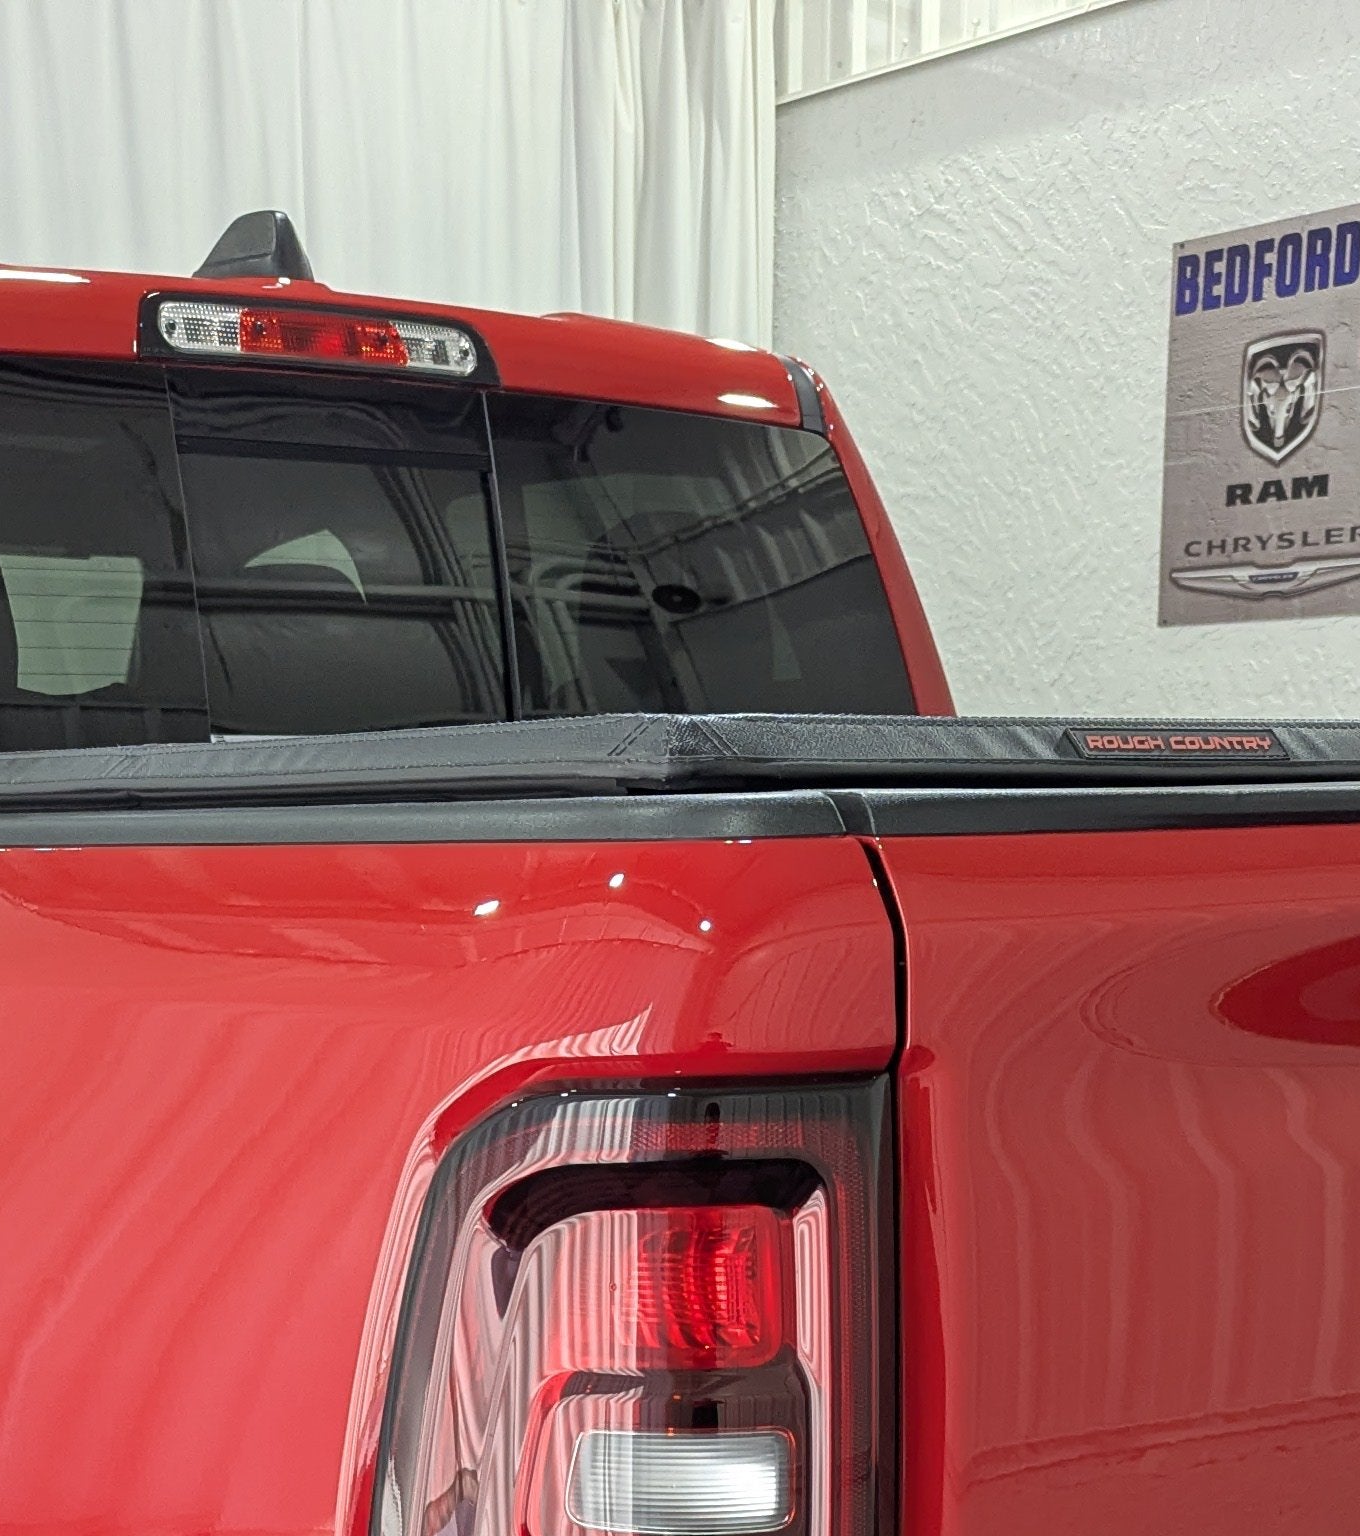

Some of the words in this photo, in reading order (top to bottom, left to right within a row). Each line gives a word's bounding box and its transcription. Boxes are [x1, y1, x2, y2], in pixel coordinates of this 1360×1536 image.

[1225, 473, 1330, 507] RAM
[1085, 734, 1166, 751] ROUGH
[1168, 734, 1272, 751] COUNTRY
